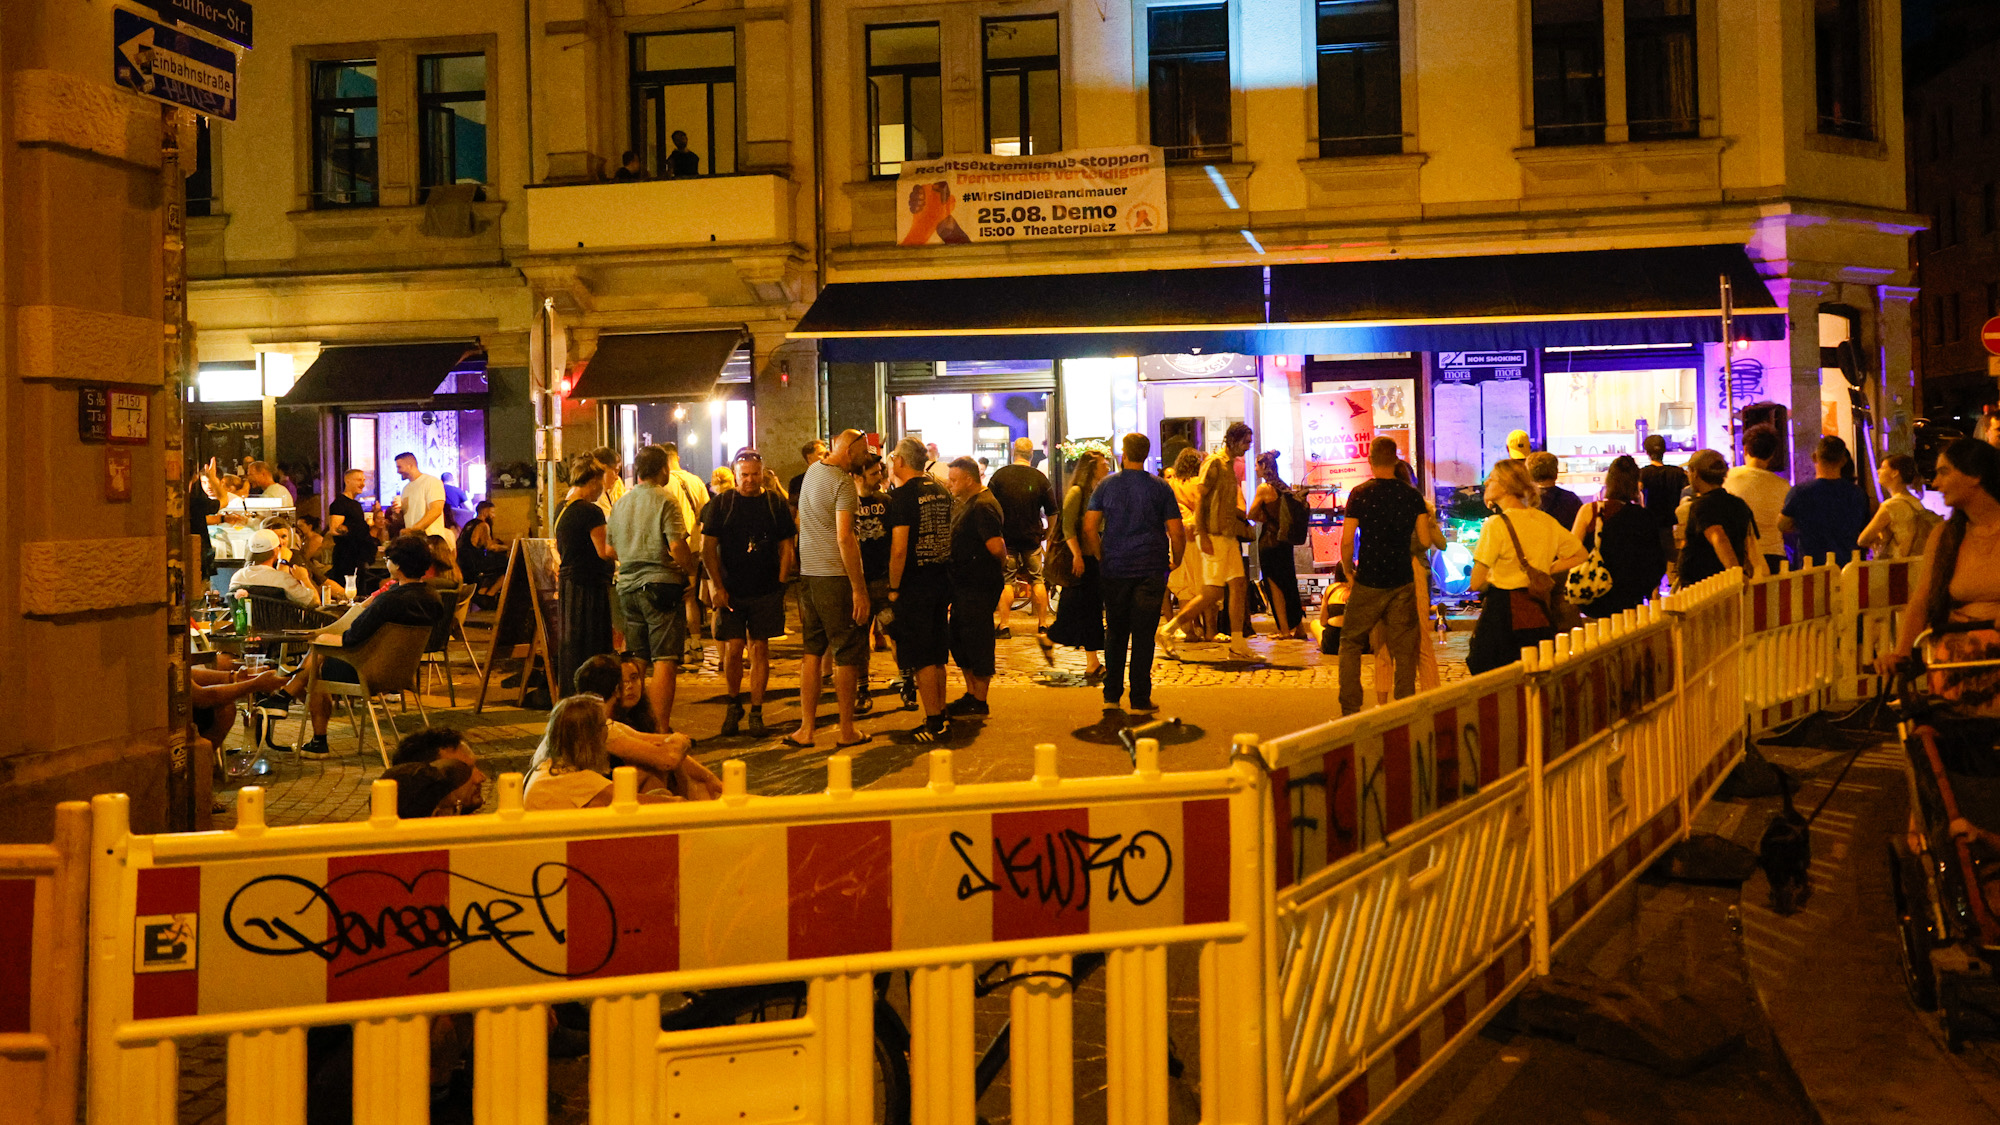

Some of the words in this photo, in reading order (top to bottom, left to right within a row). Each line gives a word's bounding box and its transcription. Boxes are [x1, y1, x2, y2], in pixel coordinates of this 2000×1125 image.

[152, 52, 230, 92] Einbahnstraße
[1080, 153, 1149, 167] stoppen
[962, 186, 1128, 202] #WirSindDieBrandmauer
[977, 206, 1047, 223] 25.08.
[1052, 204, 1117, 220] Demo
[979, 226, 1015, 237] 15:00
[1023, 222, 1116, 236] Theaterplatz
[1467, 355, 1485, 363] NON
[1486, 354, 1522, 363] SMOKING
[1444, 370, 1471, 379] mora
[1494, 368, 1521, 377] mora
[1309, 432, 1371, 446] KOBAYASHI
[1311, 442, 1372, 462] MARU
[1284, 756, 1391, 886] FCK
